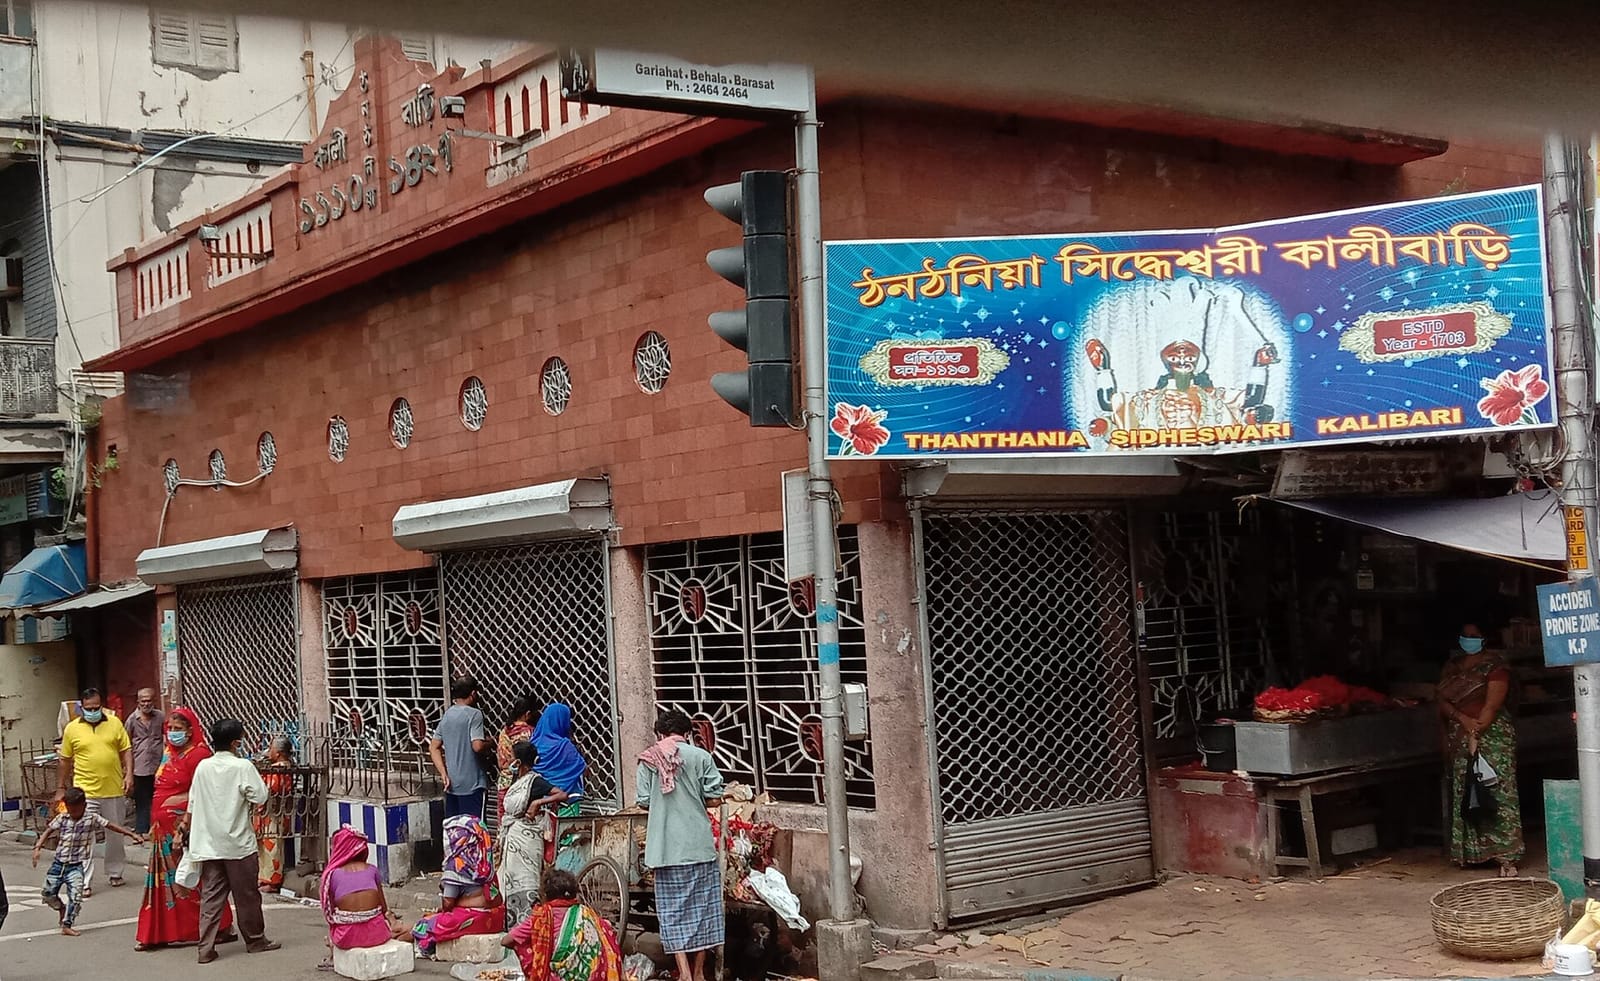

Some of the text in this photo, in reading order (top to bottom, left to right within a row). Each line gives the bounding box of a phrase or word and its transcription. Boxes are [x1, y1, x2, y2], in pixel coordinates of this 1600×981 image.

[635, 63, 775, 90] Gariahat Behala Barasat
[693, 83, 719, 96] 2464
[722, 86, 748, 99] 2464
[851, 223, 1513, 308] ঠনঠনিয়া সিদ্ধেশ্বরী কালীবাড়ি
[1401, 319, 1445, 335] ESTD
[1383, 337, 1417, 351] Year
[1430, 333, 1465, 347] 1703
[903, 407, 1463, 449] THANTHANIA SIDHESWARI KALIBARI
[1550, 589, 1593, 612] ACCIDENT
[1545, 612, 1600, 636] PRONE ZONE
[1568, 638, 1588, 655] K.P
